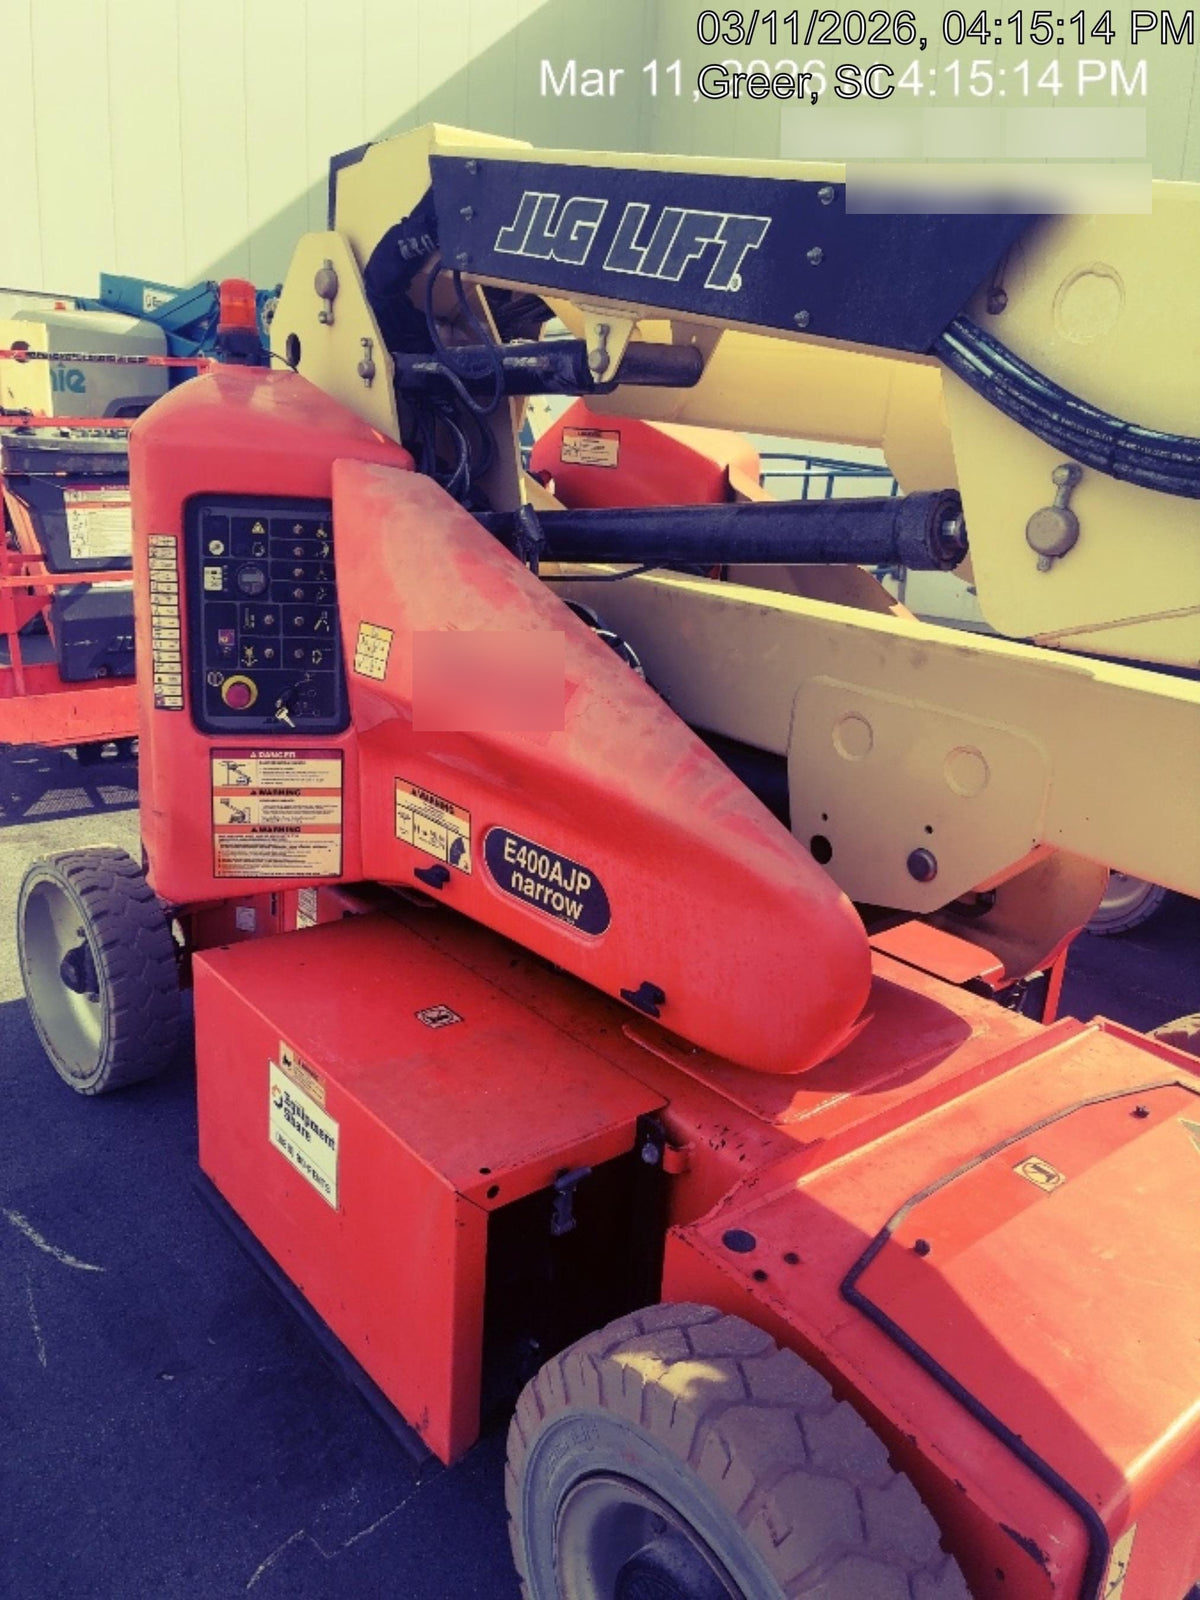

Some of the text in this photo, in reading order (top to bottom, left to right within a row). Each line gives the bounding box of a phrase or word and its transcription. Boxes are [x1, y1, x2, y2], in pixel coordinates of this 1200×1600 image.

[493, 190, 773, 291] JLG LIFT
[50, 362, 87, 393] nie
[504, 837, 592, 895] E400AJP
[511, 870, 584, 920] narrow
